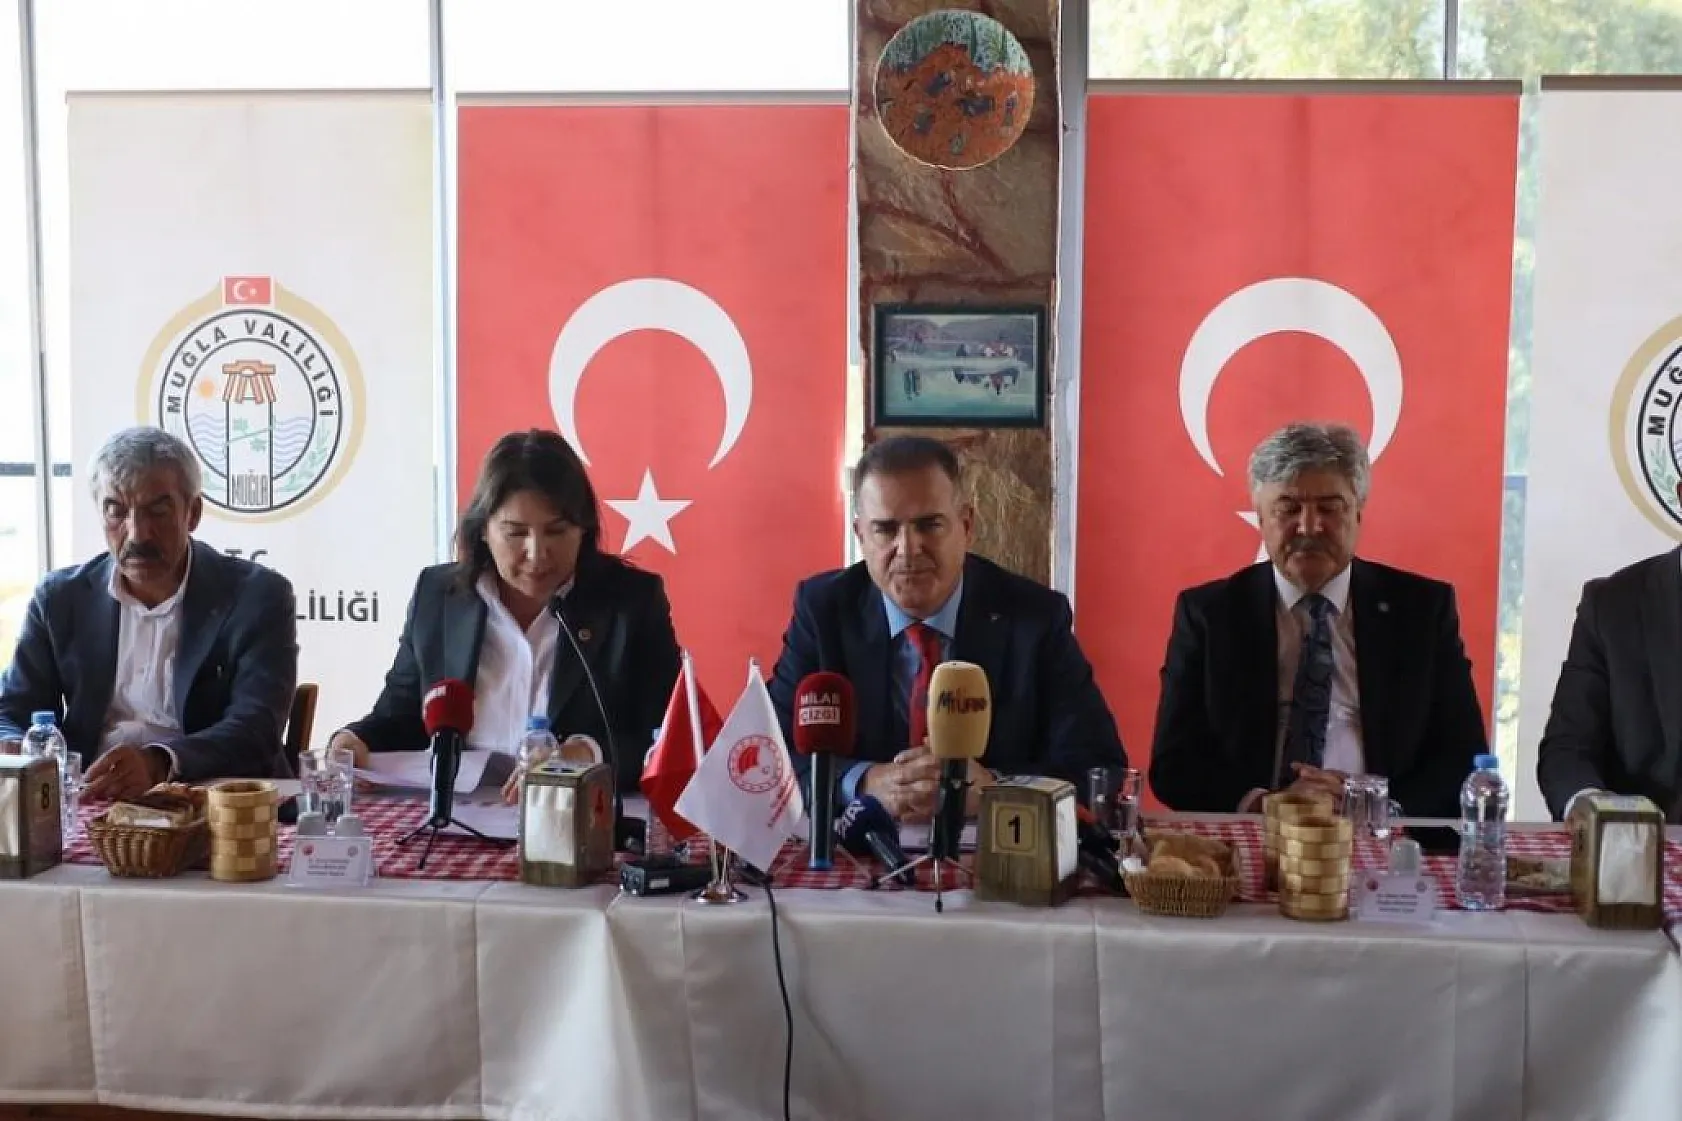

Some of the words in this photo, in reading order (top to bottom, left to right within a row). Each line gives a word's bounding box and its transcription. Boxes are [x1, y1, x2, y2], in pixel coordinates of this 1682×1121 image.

[244, 319, 338, 416] VALİLİĞİ
[41, 782, 50, 810] 8
[1008, 815, 1021, 844] 1
